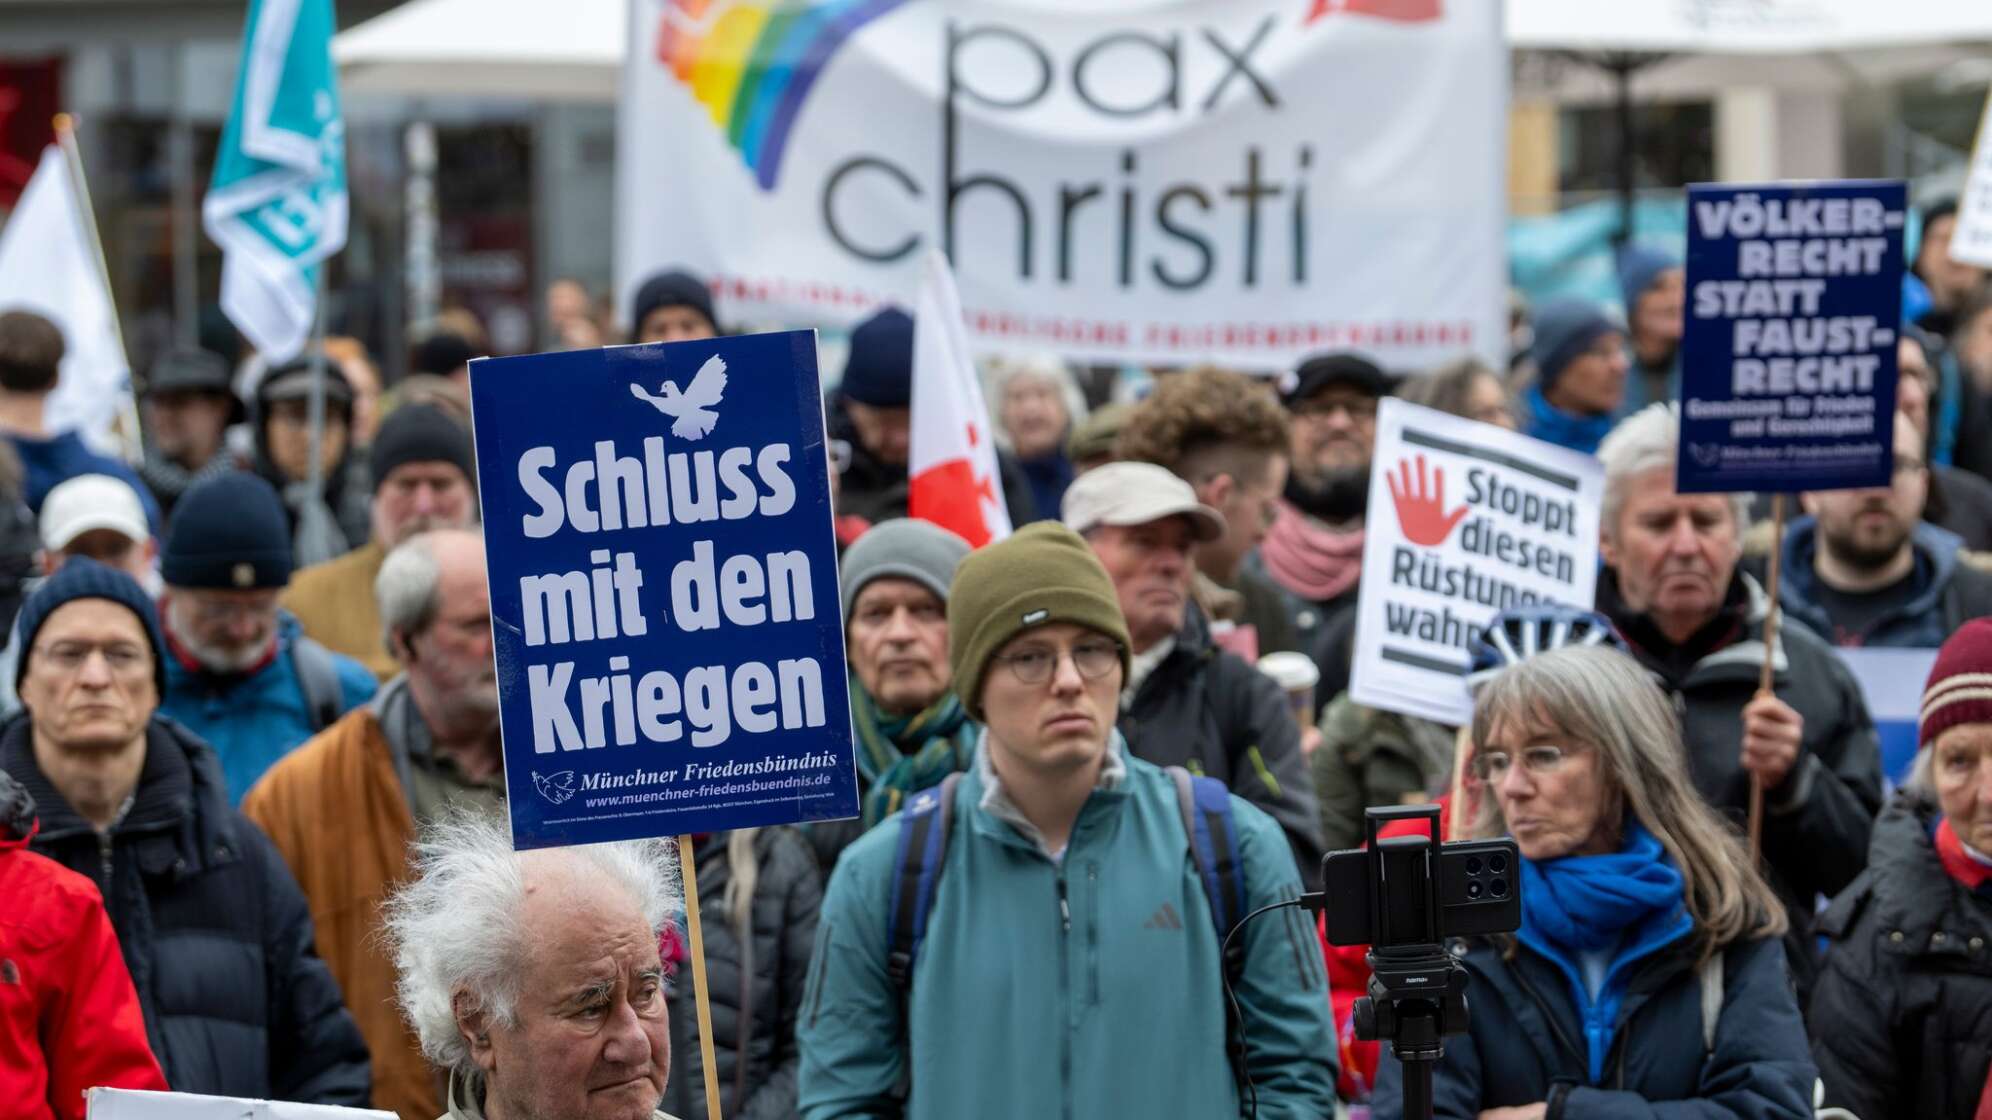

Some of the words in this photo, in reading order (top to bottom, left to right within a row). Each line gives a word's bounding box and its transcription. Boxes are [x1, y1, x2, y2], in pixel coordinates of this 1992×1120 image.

[945, 16, 1280, 132] pax
[822, 138, 1314, 291] christi
[1696, 193, 1904, 240] VÖLKER-
[1738, 238, 1887, 277] RECHT
[1693, 279, 1826, 319] STATT
[1733, 315, 1895, 357] FAUST-
[1732, 355, 1881, 395] RECHT
[518, 436, 797, 538] Schluss
[1466, 467, 1577, 537] Stoppt
[1460, 514, 1575, 584] diesen
[519, 549, 647, 646] mit
[670, 540, 815, 632] den
[528, 656, 826, 754] Kriegen
[580, 769, 678, 791] Münchner
[683, 750, 837, 781] Friedensbündnis
[585, 773, 831, 808] www.muenchner-friedensbuendnis.de
